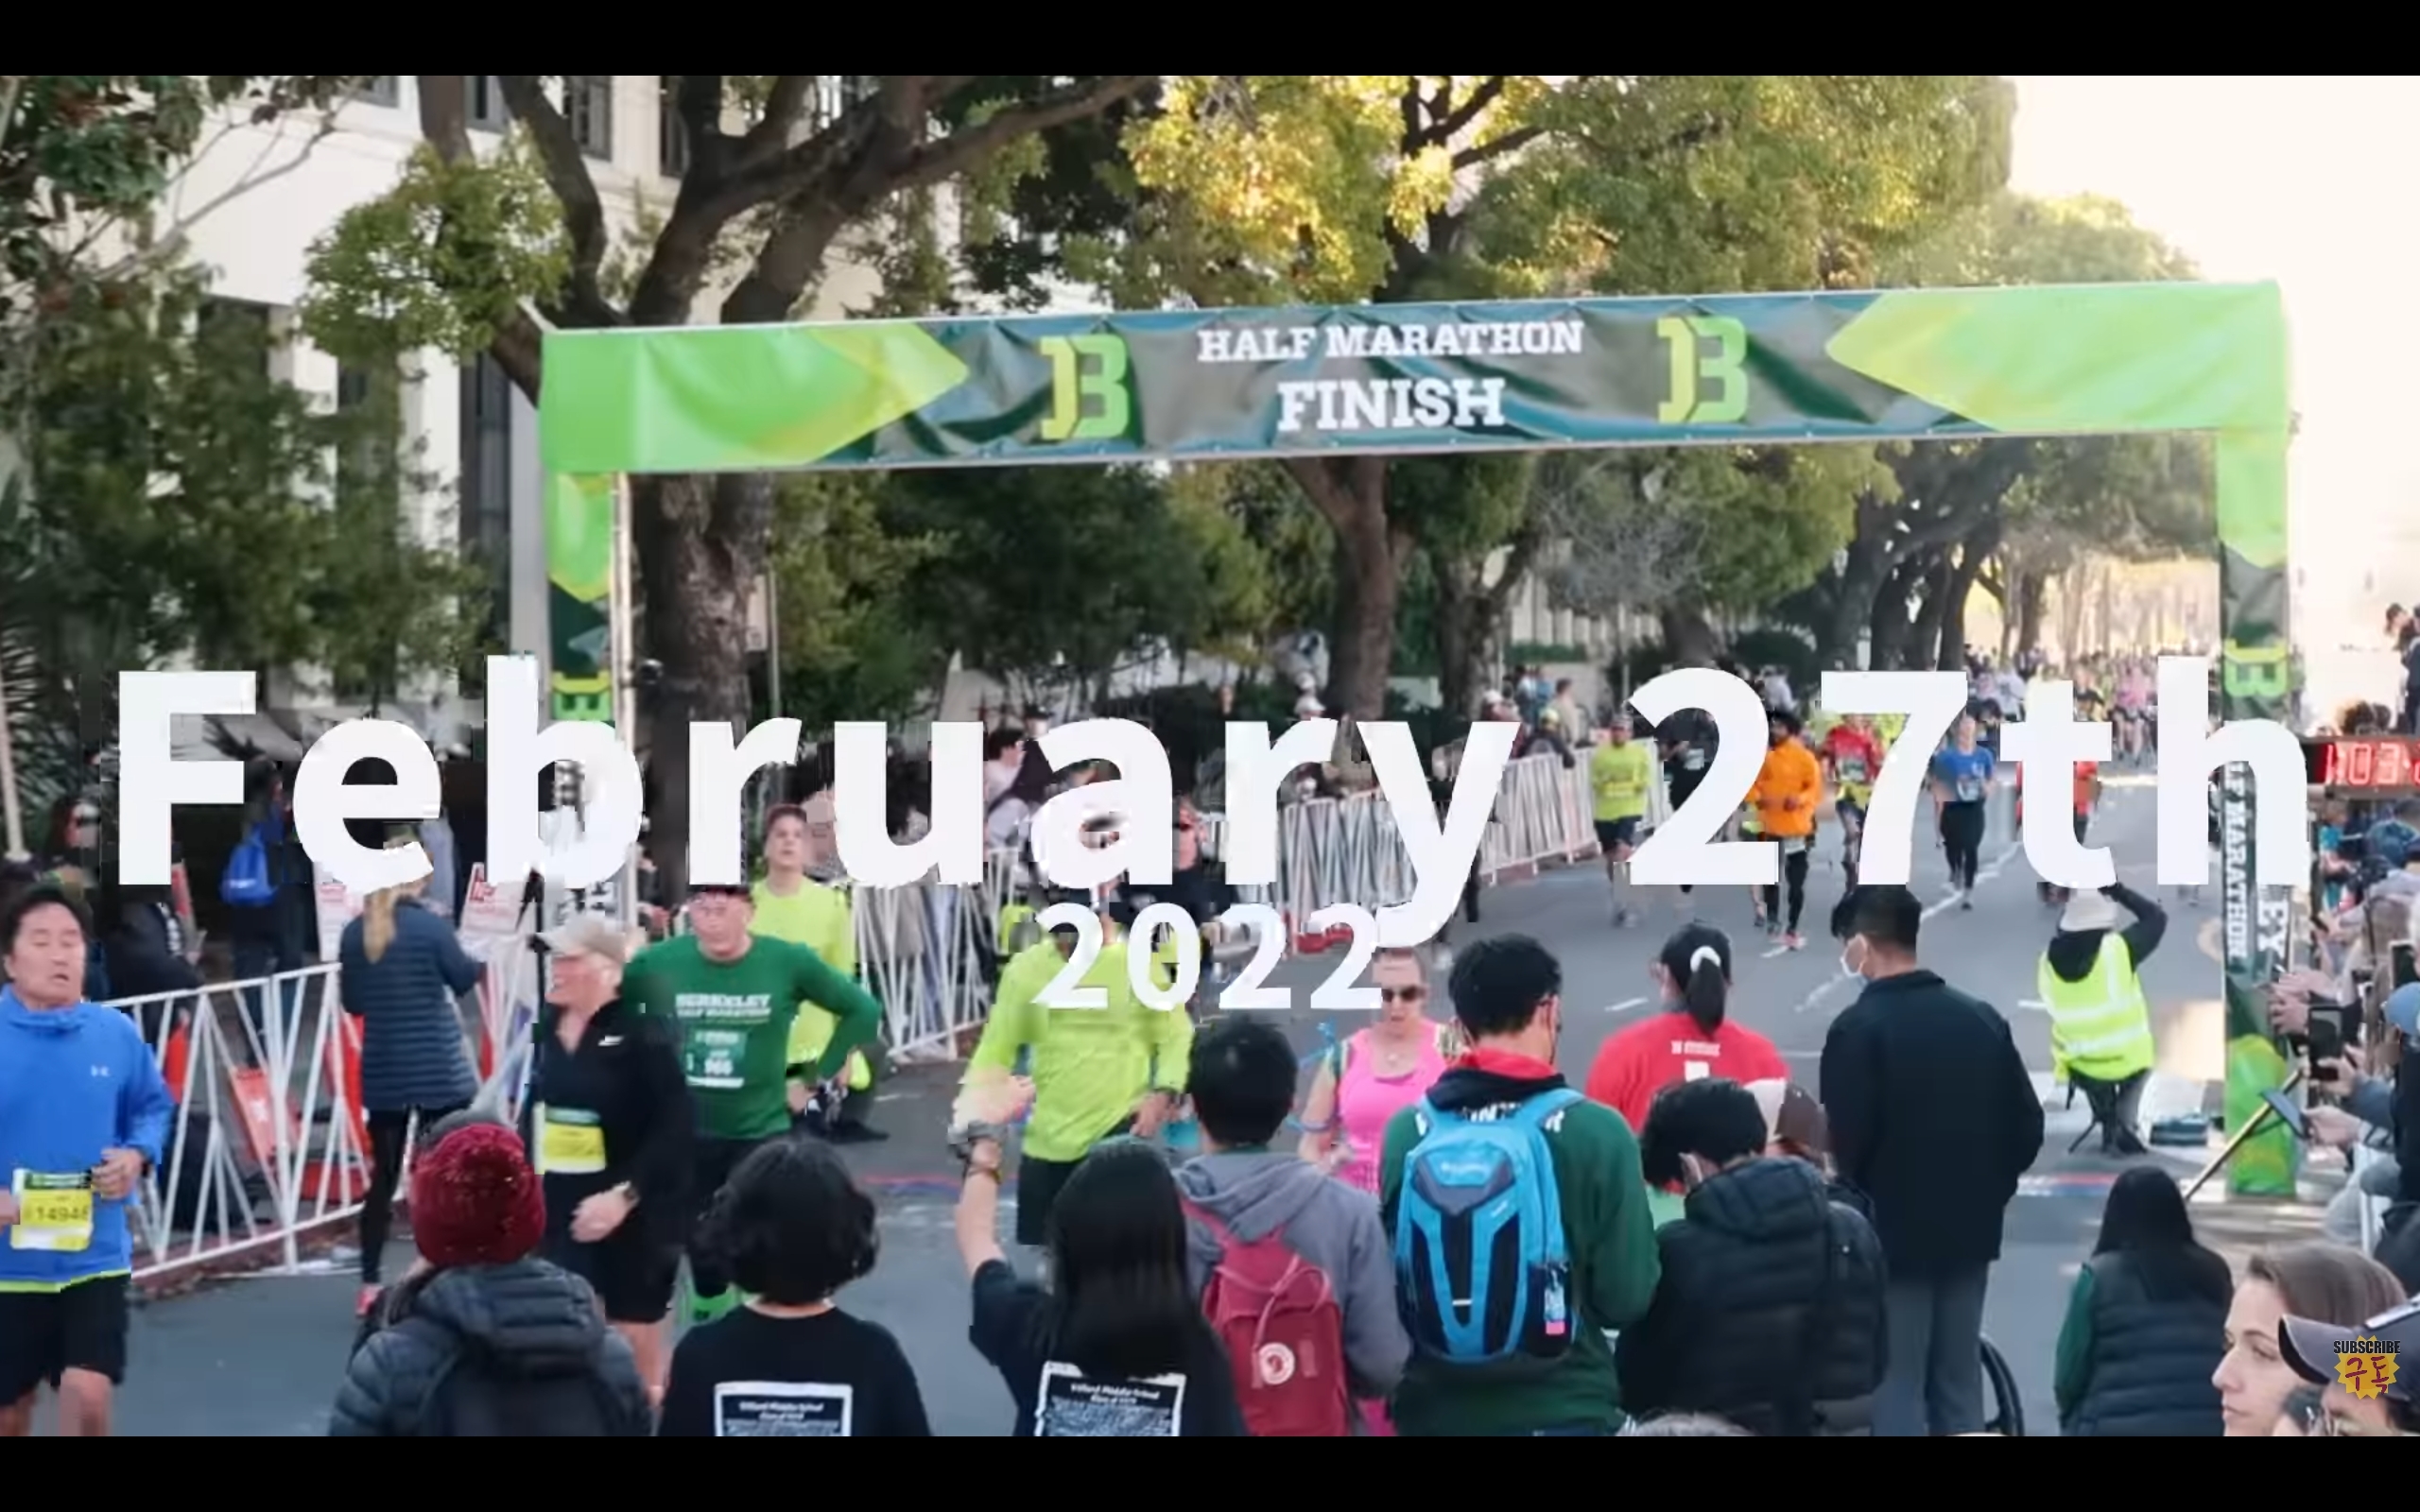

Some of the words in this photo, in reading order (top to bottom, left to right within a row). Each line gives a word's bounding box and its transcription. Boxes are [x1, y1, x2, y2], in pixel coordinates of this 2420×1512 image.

[1197, 325, 1316, 362] HALF
[1325, 319, 1585, 358] MARATHON
[1276, 378, 1506, 432] FINISH
